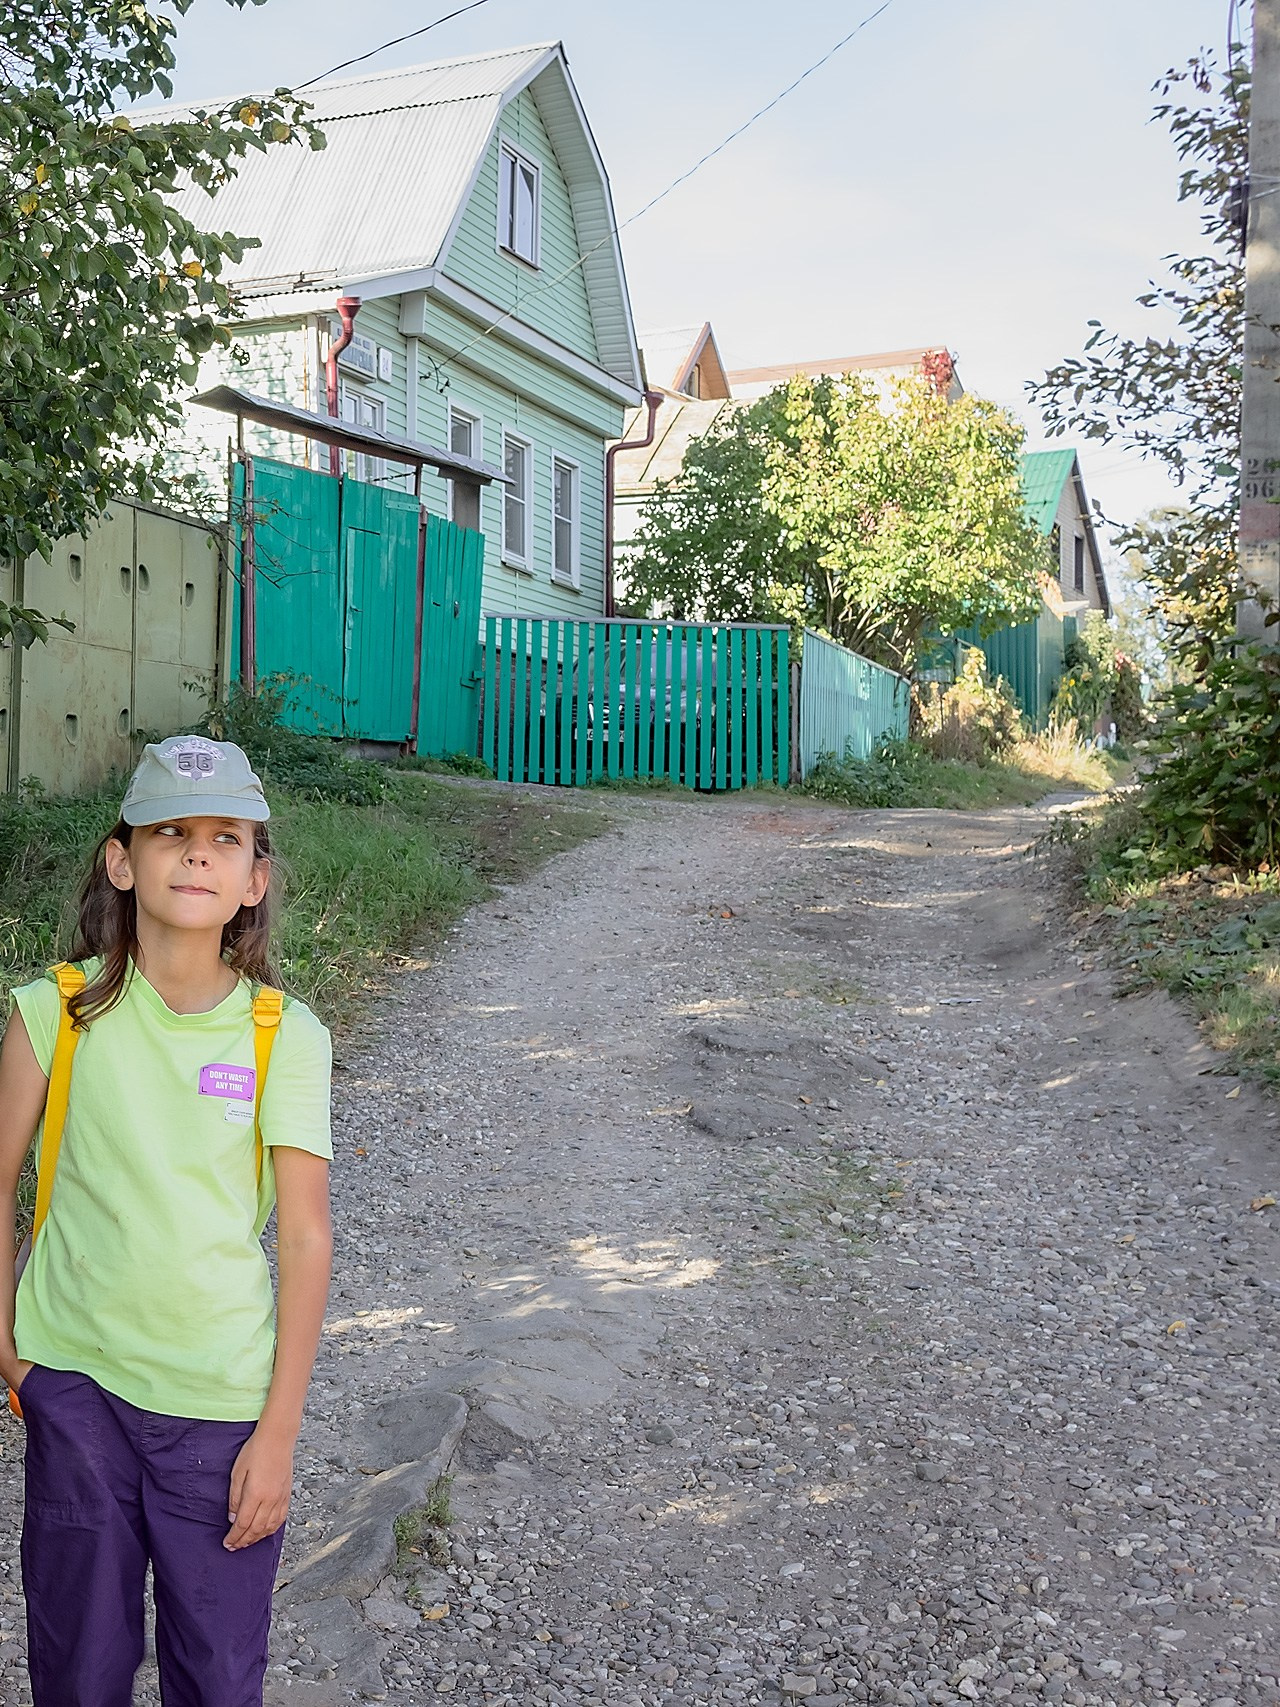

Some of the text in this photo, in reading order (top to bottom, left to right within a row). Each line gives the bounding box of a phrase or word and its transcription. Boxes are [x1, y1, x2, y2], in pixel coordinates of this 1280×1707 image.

[1245, 481, 1274, 499] 96
[178, 752, 213, 771] 56
[209, 1070, 249, 1084] DON'T WASTE
[215, 1081, 244, 1093] ANY TIME
